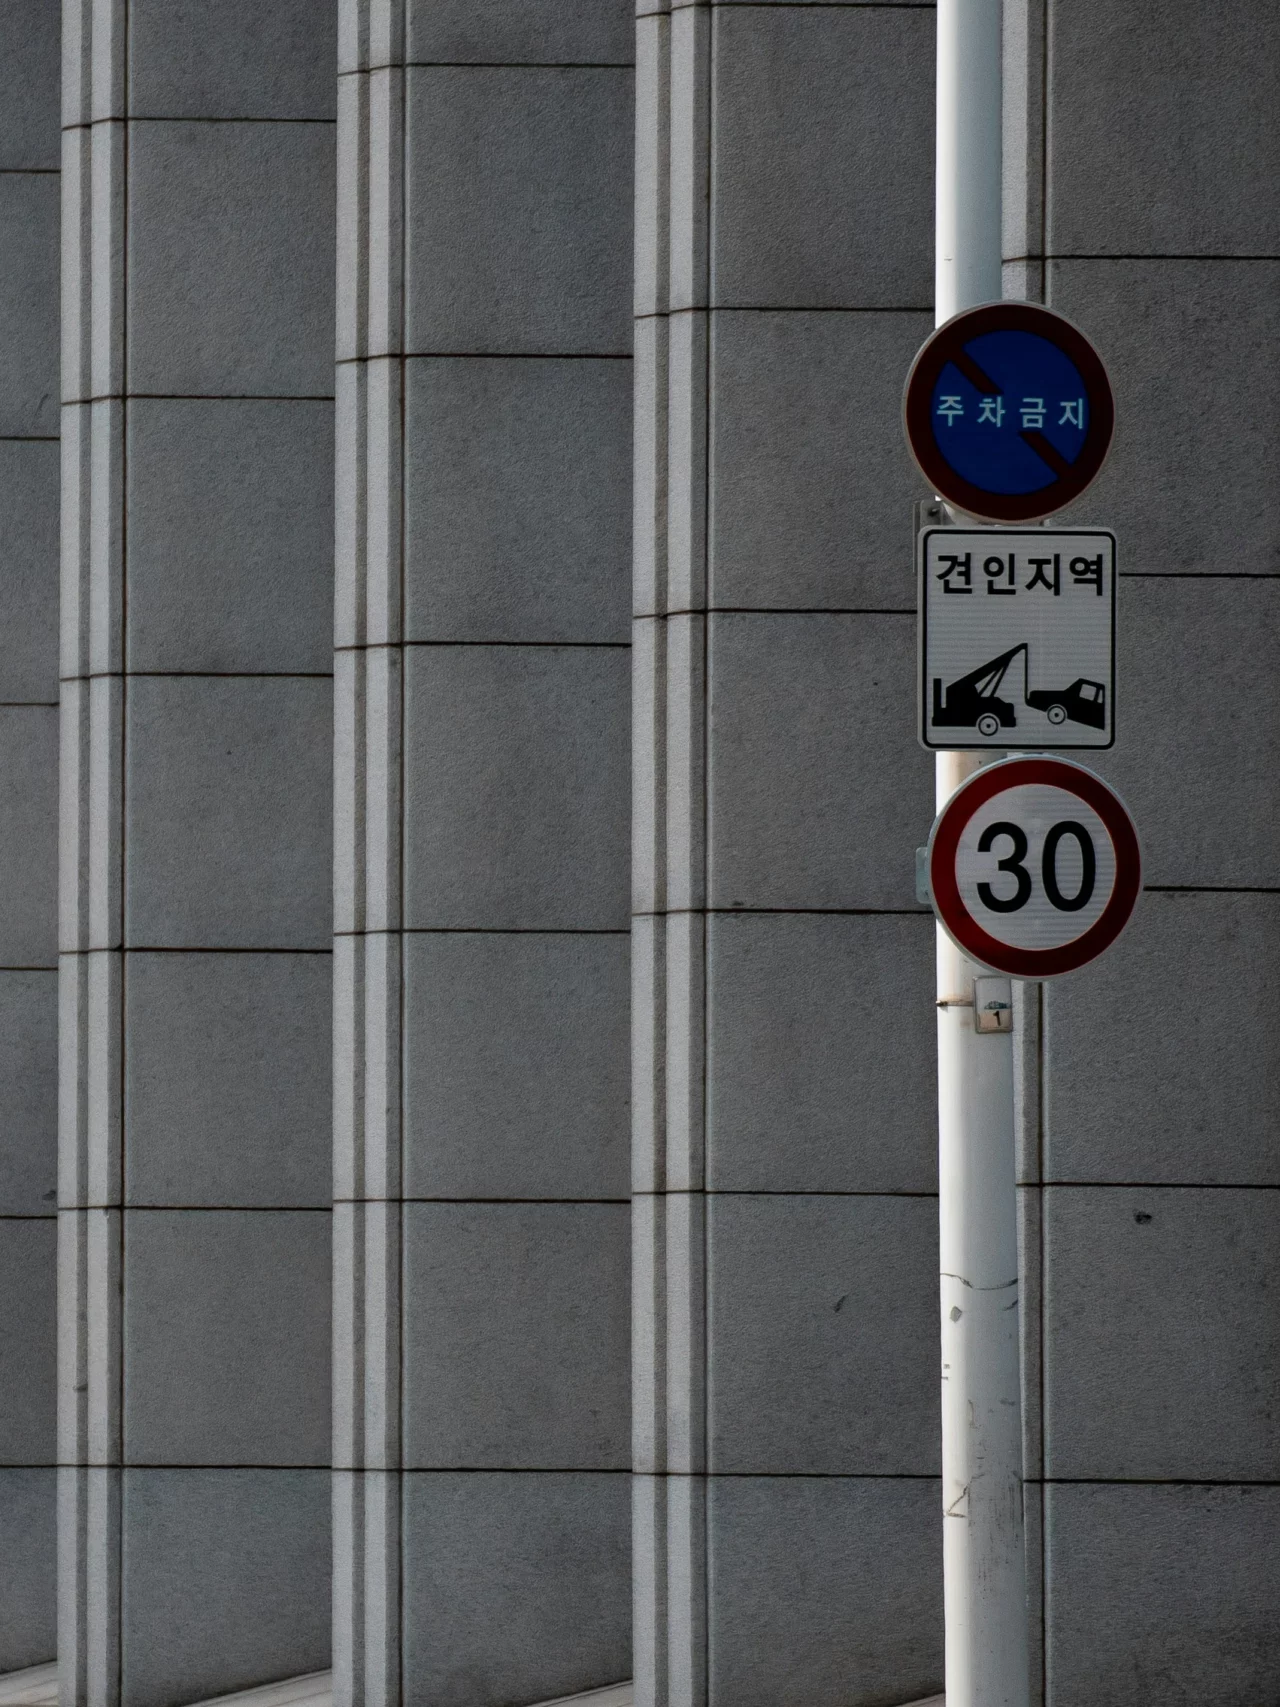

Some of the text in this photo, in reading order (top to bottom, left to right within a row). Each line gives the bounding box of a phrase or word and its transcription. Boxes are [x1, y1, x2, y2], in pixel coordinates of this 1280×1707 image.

[936, 394, 1085, 430] 주차금지
[935, 552, 1105, 597] 견인지역
[976, 820, 1097, 915] 30
